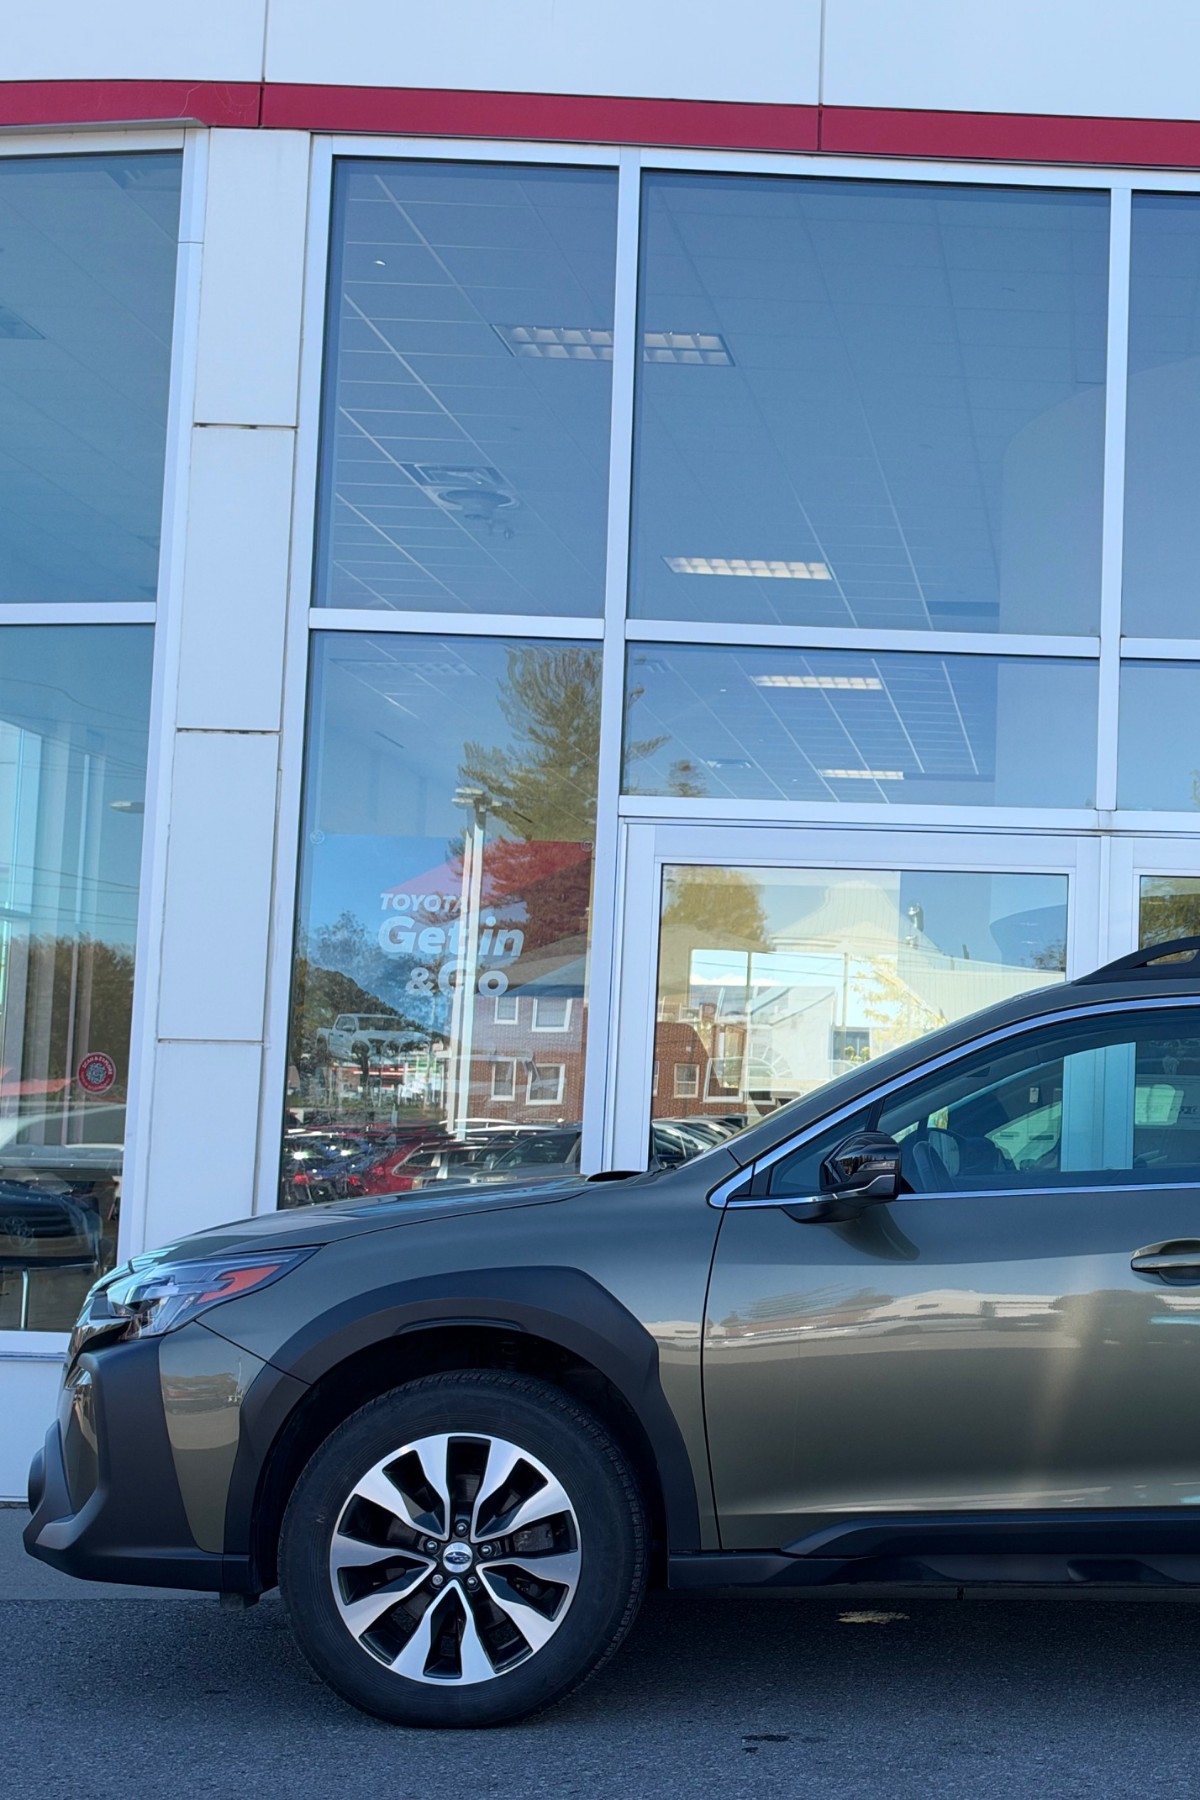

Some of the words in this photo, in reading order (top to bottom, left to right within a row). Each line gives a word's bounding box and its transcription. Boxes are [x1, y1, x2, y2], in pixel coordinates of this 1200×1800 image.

[380, 893, 469, 912] TOYOTA
[378, 915, 470, 955] Get
[478, 916, 525, 956] in
[405, 967, 434, 997] &
